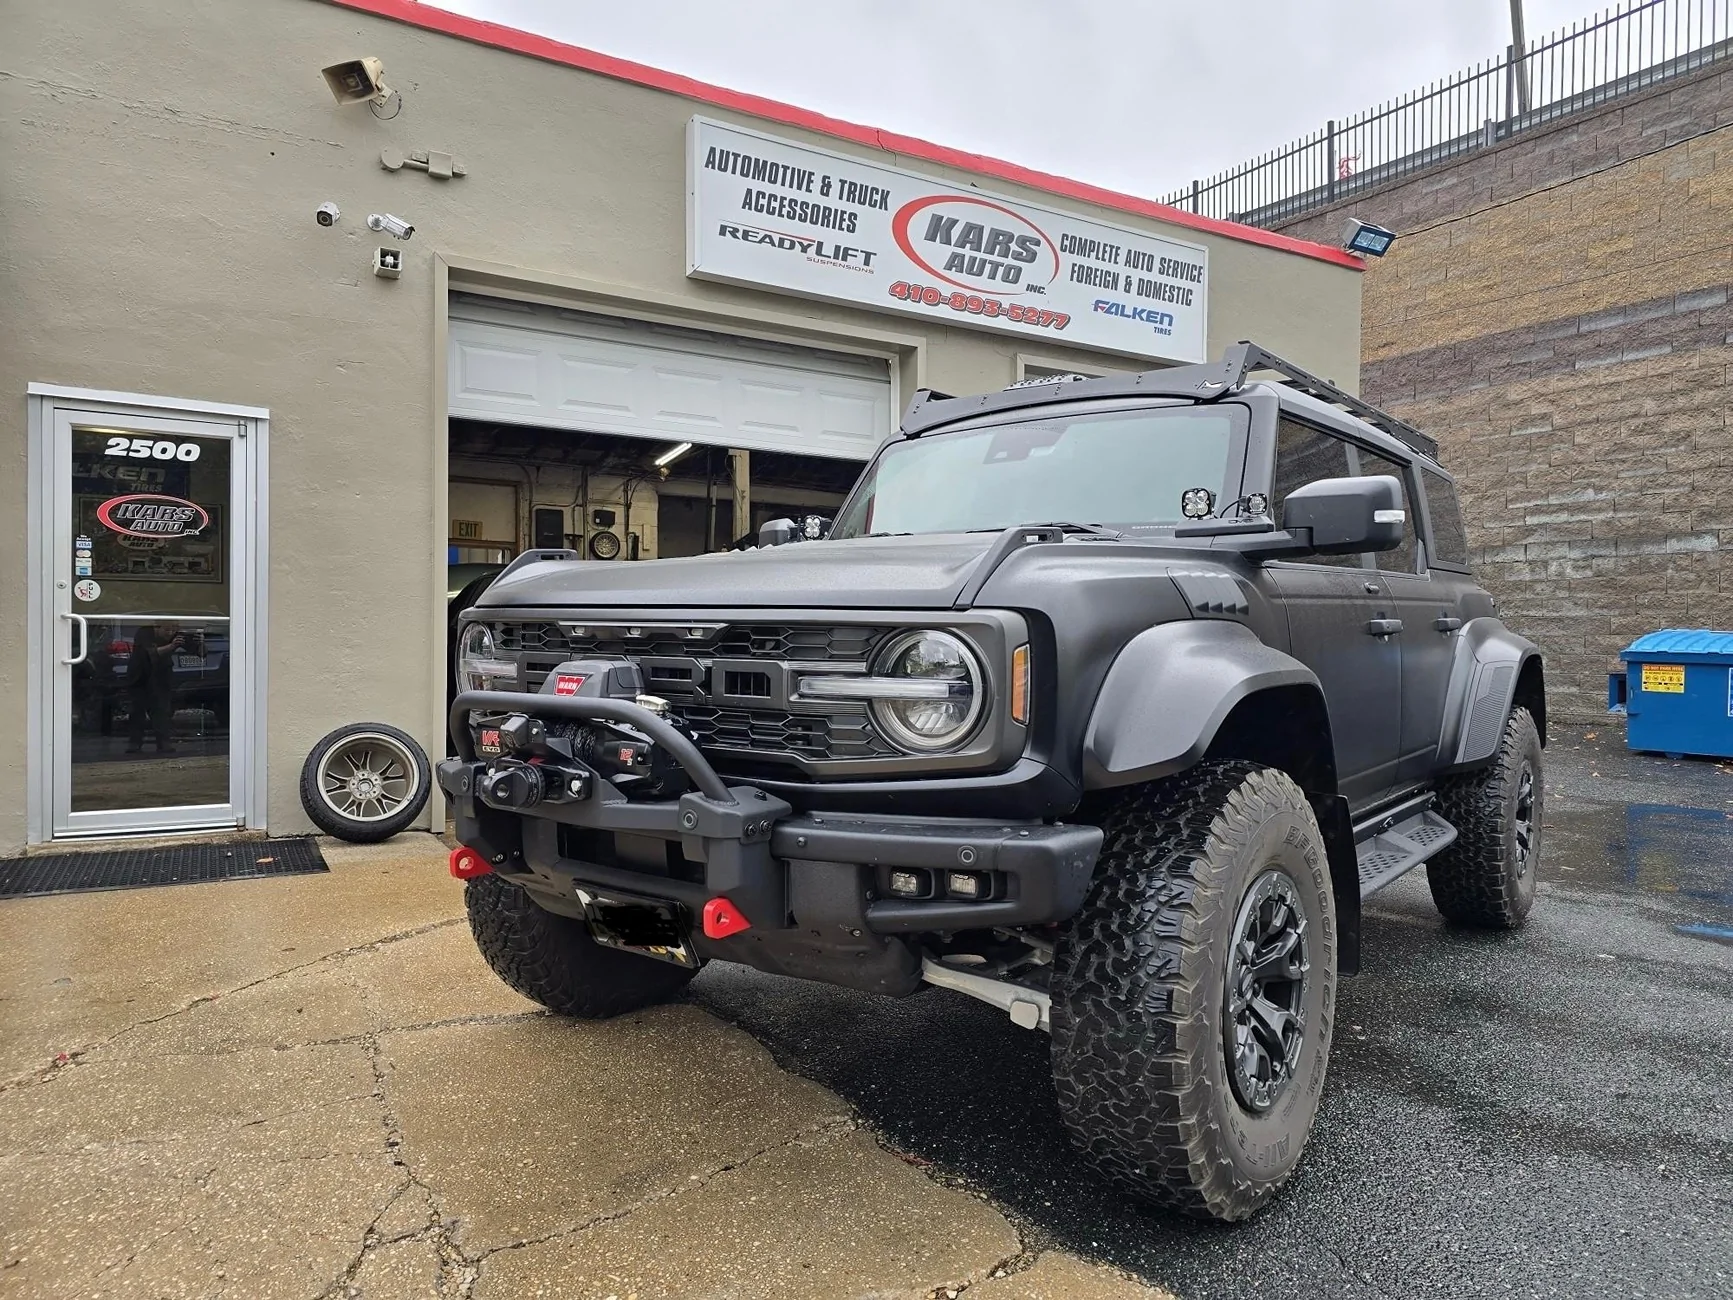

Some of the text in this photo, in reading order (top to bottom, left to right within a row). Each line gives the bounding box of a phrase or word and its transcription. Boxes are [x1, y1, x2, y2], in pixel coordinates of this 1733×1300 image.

[704, 146, 891, 211] AUTOMOTIVE & TRUCK
[741, 188, 858, 234] ACCESSORIES
[718, 224, 877, 266] READYLIFT
[923, 213, 1042, 265] KARS
[806, 256, 874, 275] SUSPENSIONS
[943, 252, 1024, 285] AUTO
[1059, 233, 1204, 284] COMPLETE AUTO SERVICE
[1025, 283, 1047, 296] INC.
[1069, 262, 1193, 307] FOREIGN & DOMESTIC
[888, 279, 1071, 331] 410-893-5277
[1091, 299, 1174, 327] FALKEN
[1153, 326, 1172, 336] TIRES
[104, 437, 201, 462] 2500
[130, 483, 163, 493] TIRES
[116, 503, 196, 521] KARS
[130, 519, 183, 532] AUTO
[459, 522, 479, 538] EXIT
[558, 682, 578, 691] WARN
[619, 748, 634, 761] 12
